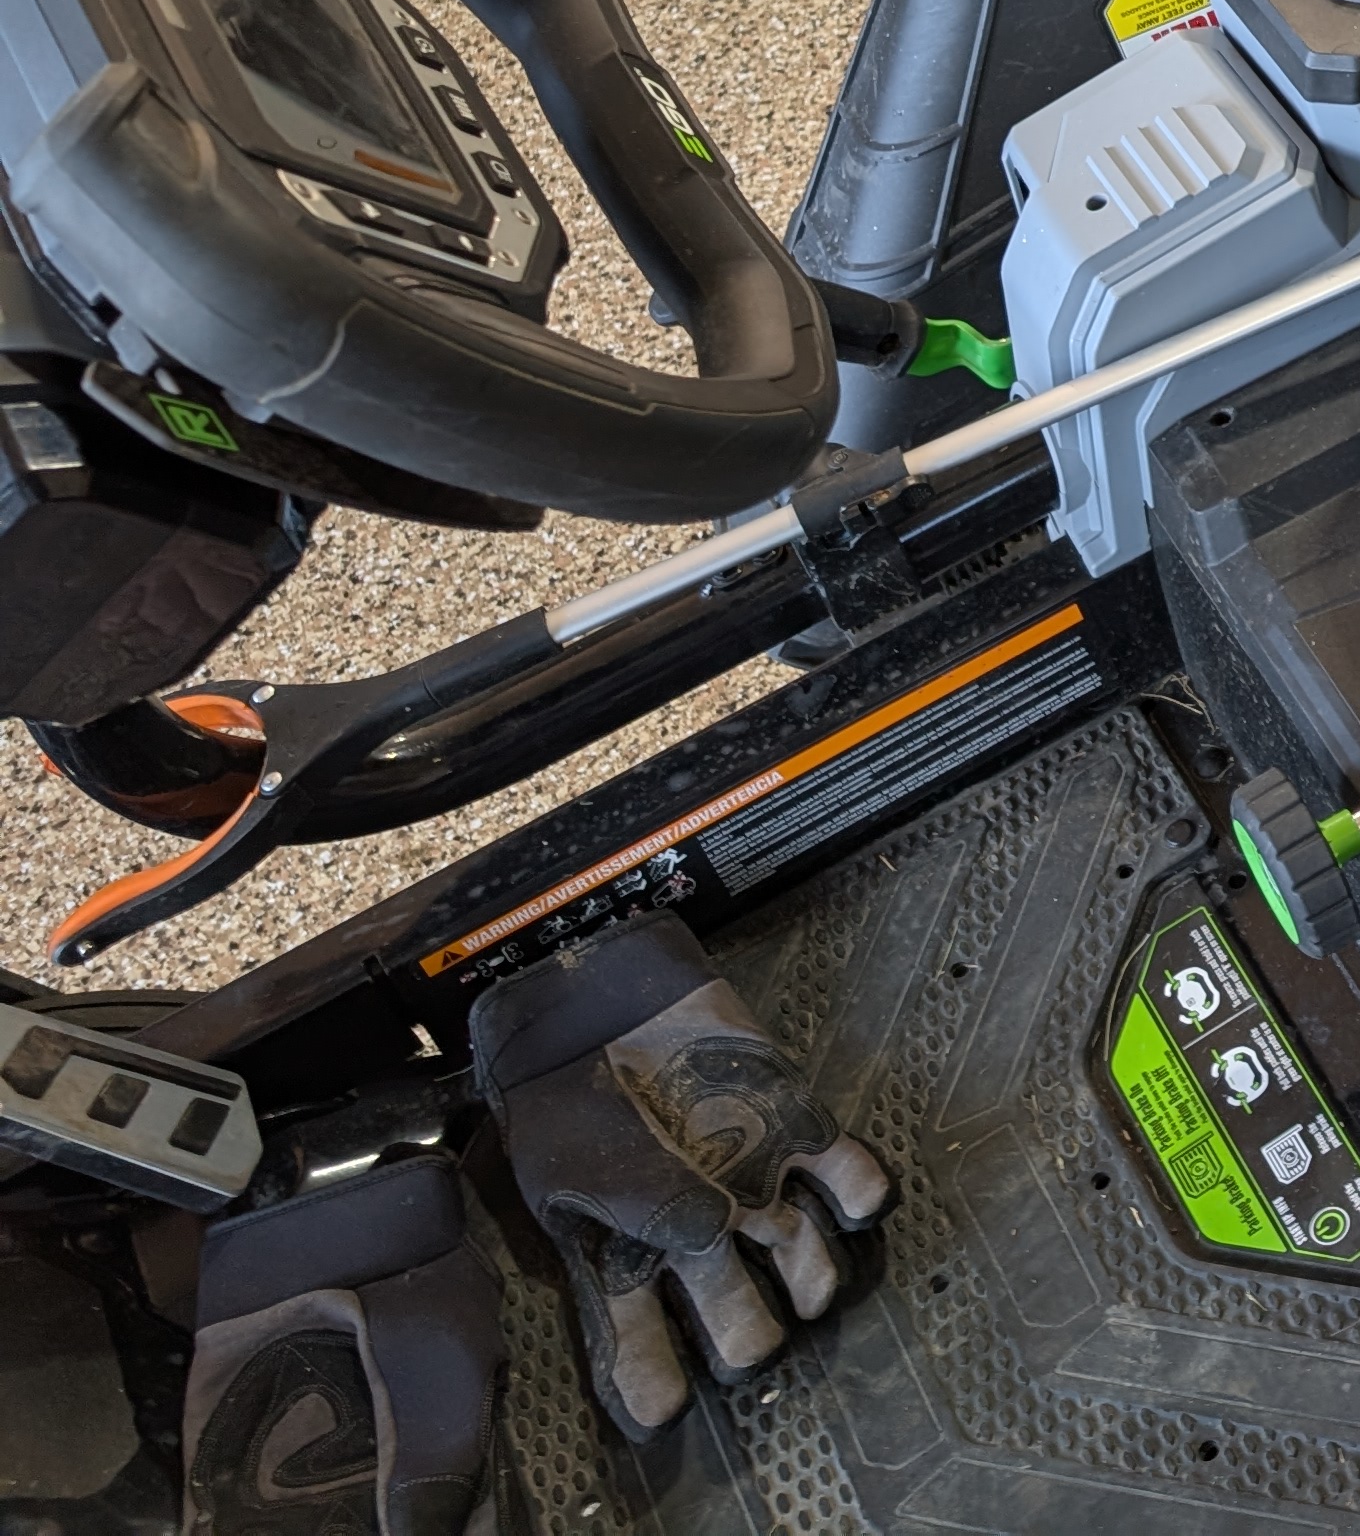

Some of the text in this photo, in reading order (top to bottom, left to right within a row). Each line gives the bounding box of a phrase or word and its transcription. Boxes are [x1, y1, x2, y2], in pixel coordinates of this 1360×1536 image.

[1136, 15, 1159, 30] AWAY
[1137, 2, 1170, 19] DISTANCE
[1161, 7, 1183, 20] FEET
[640, 76, 713, 163] EGO
[167, 405, 225, 444] R
[461, 768, 786, 954] WARNING/AVERTISSEMENT/ADVERTENCIA
[1125, 1082, 1177, 1152] Parking Brake On
[1150, 1063, 1204, 1135] Parking Brake Off
[1217, 1174, 1266, 1237] Parking Brake
[1271, 1194, 1309, 1246] START UP INFO
